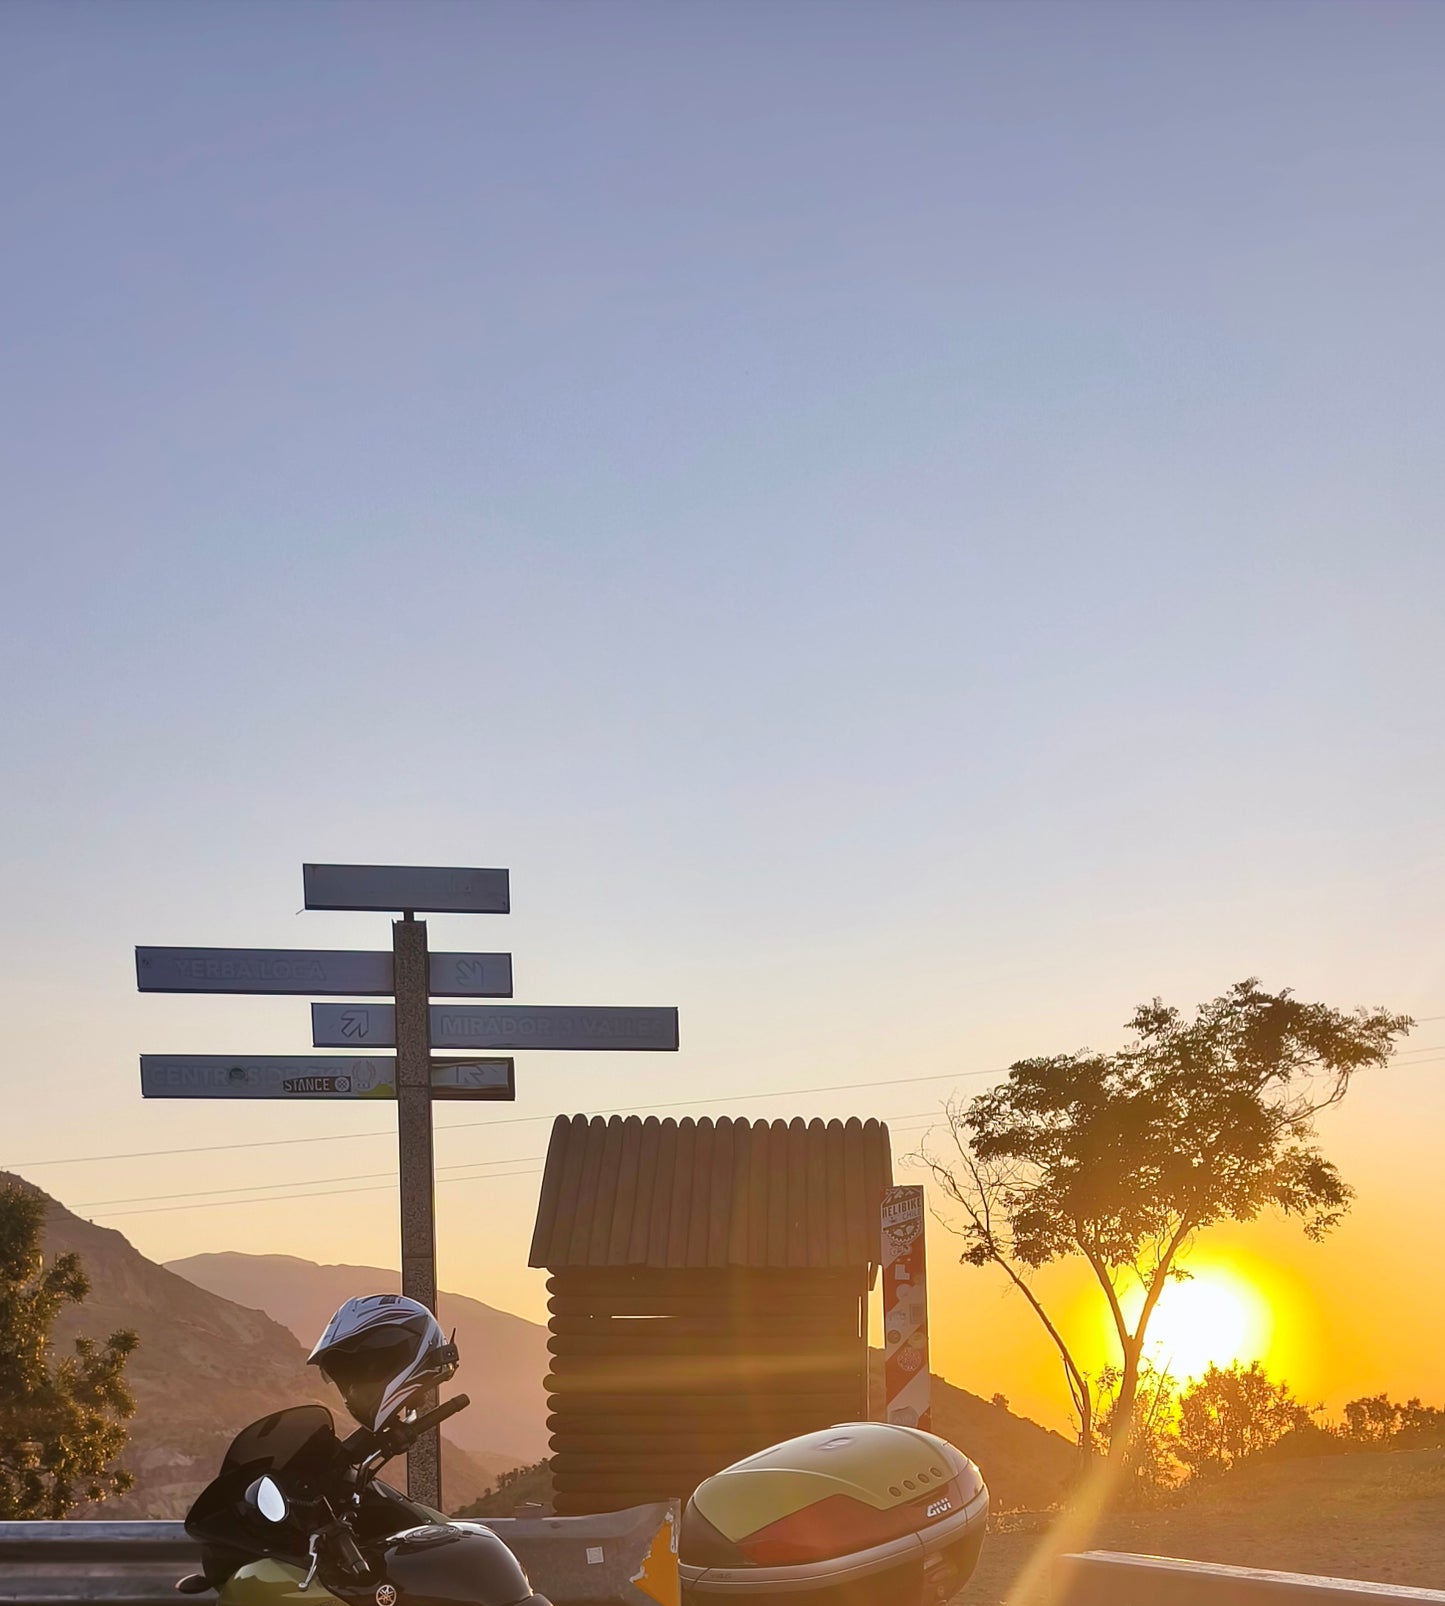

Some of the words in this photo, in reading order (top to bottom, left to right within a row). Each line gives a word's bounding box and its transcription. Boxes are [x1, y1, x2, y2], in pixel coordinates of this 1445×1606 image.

[440, 1015, 552, 1036] MIRADOR
[151, 1064, 260, 1088] CENTRS
[284, 1078, 330, 1092] STANCE
[926, 1497, 952, 1518] GIVI
